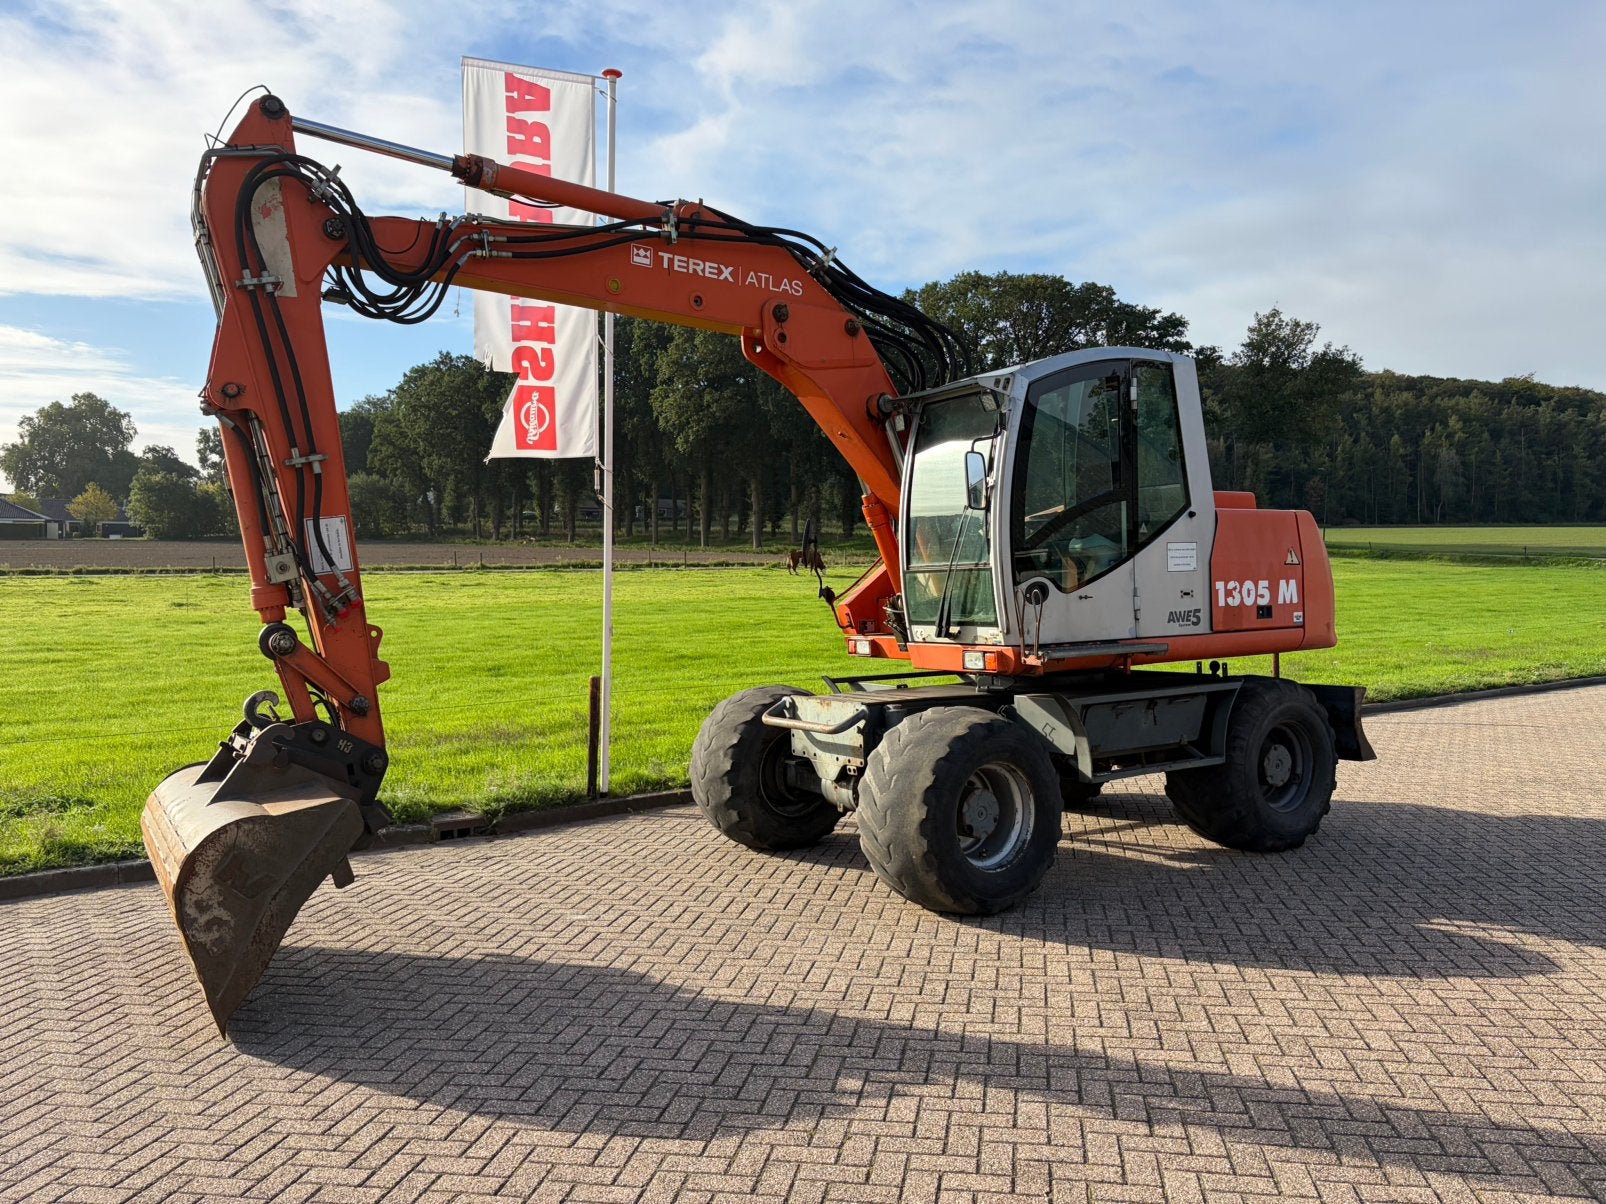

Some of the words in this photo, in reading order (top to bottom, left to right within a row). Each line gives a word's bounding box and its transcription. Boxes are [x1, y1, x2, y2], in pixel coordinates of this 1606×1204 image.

[658, 251, 734, 282] TEREX
[746, 271, 803, 296] ATLAS
[1215, 580, 1271, 607] 1305
[1277, 579, 1299, 604] M
